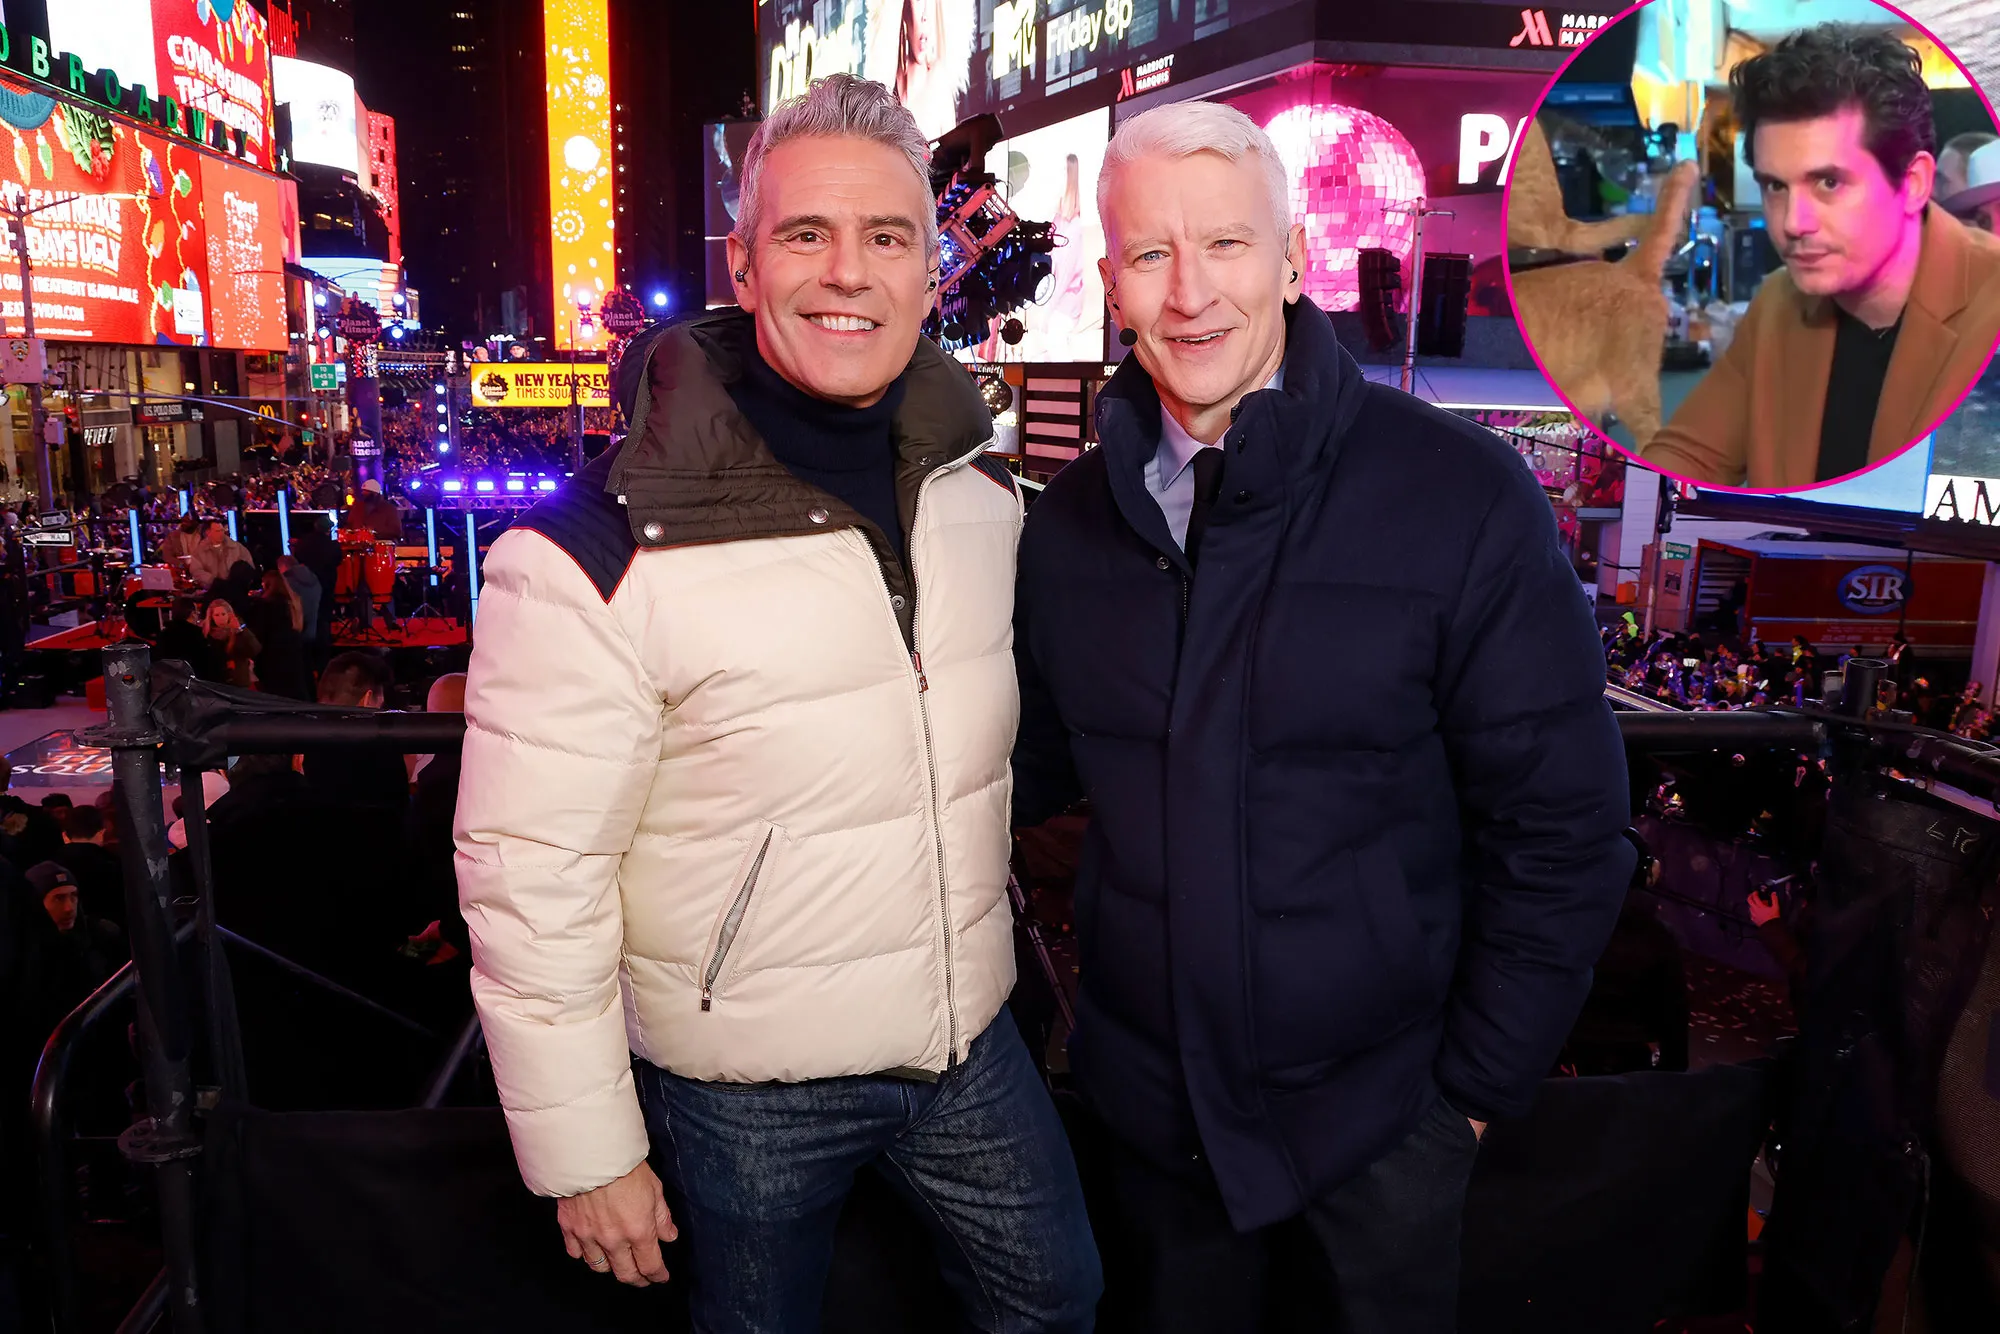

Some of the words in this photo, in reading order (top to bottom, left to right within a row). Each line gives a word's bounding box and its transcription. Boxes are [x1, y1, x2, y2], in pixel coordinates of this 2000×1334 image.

[1562, 14, 1614, 29] MARR
[1046, 9, 1102, 60] Friday
[1103, 0, 1133, 41] 8p
[1136, 54, 1174, 78] MARRIOTT
[1136, 70, 1170, 91] MARQUIS
[32, 35, 248, 157] BROADWAY
[78, 230, 121, 273] UGLY
[341, 319, 371, 329] planet
[604, 312, 633, 322] planet
[608, 319, 640, 327] fitness
[345, 326, 377, 334] fitness
[515, 373, 545, 387] NEW
[548, 373, 591, 387] YEAR'S
[593, 374, 609, 387] EV
[516, 387, 546, 399] TIMES
[548, 387, 588, 399] SQUARE
[1848, 575, 1904, 600] SIR
